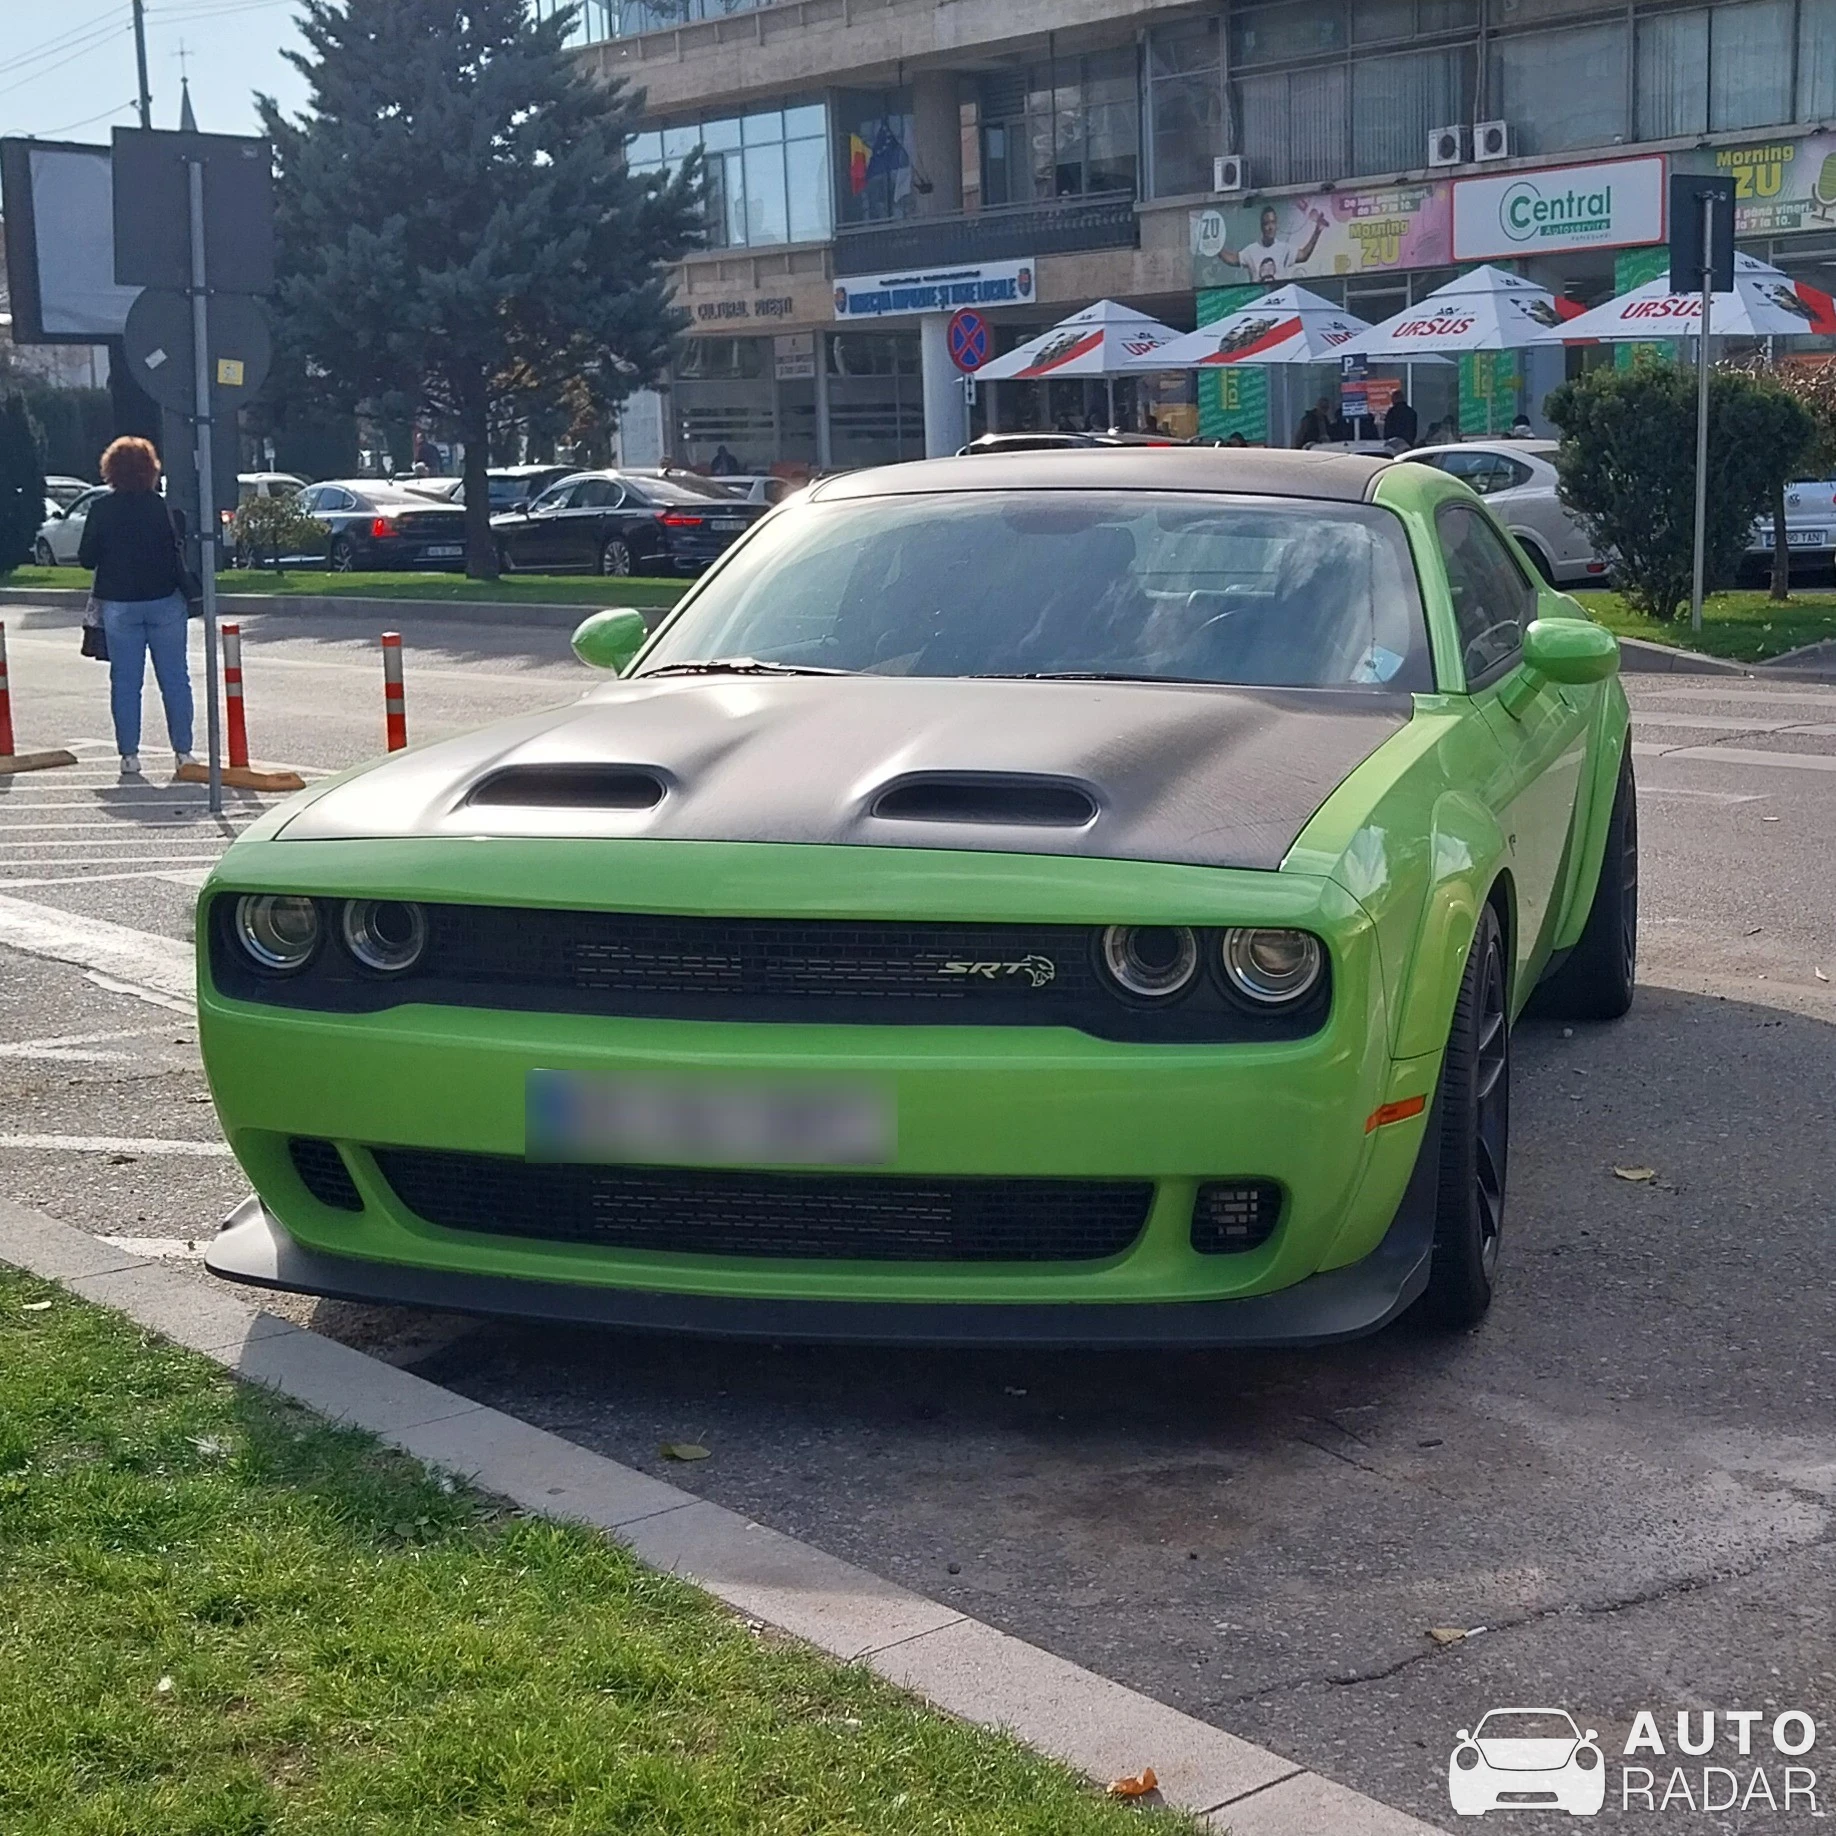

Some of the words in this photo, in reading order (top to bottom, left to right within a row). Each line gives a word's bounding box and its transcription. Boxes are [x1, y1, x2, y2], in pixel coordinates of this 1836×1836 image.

[1716, 145, 1795, 167] Morning
[1732, 163, 1782, 199] ZU
[1510, 185, 1611, 229] Central
[1202, 217, 1220, 241] ZU
[1349, 219, 1409, 239] Morning
[1361, 237, 1399, 267] ZU
[1391, 317, 1476, 338] URSUS
[1344, 357, 1354, 373] P
[1228, 368, 1241, 410] tral
[938, 962, 1031, 979] SRT
